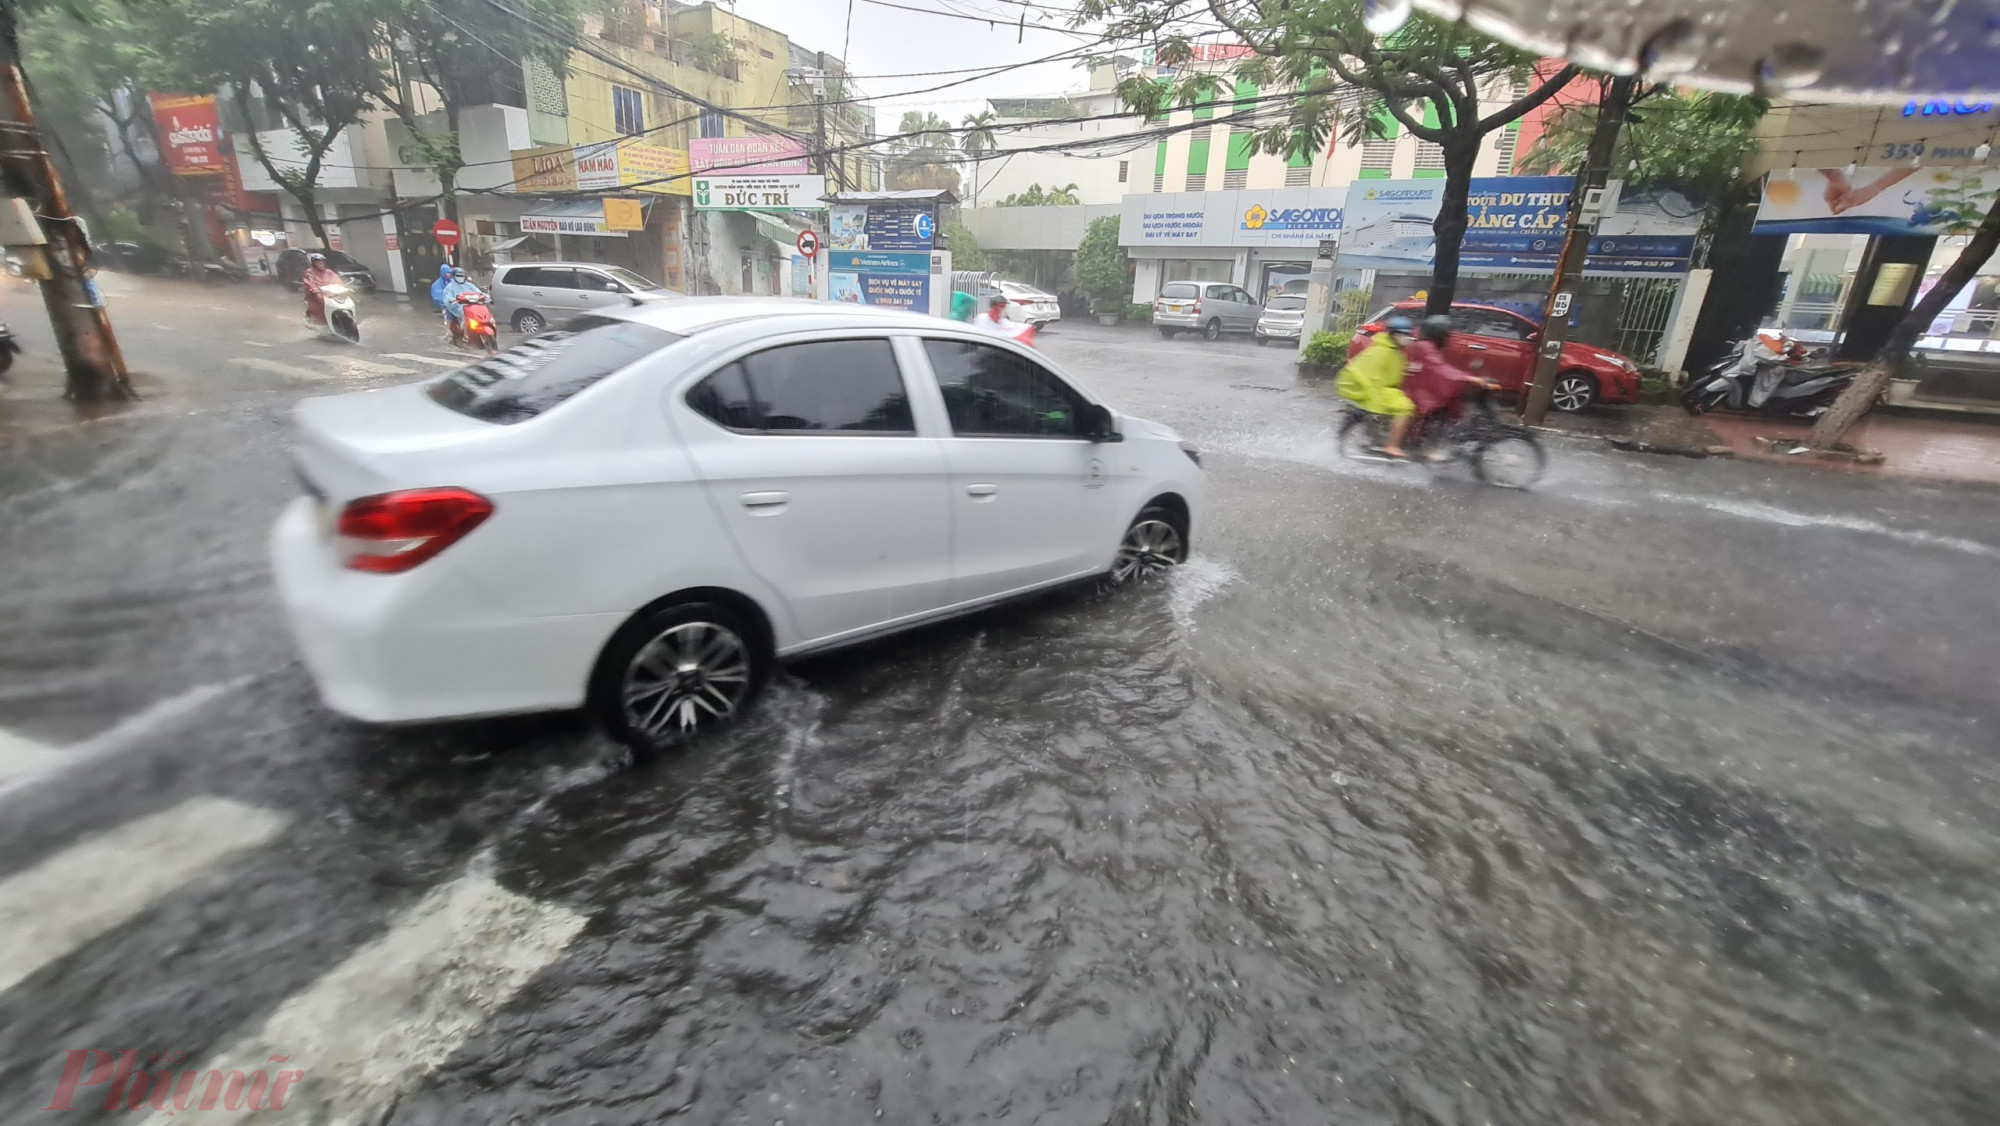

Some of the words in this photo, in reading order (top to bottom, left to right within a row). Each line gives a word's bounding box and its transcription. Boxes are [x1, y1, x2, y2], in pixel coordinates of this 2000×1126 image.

[1882, 142, 1925, 160] 359
[577, 158, 597, 173] NAM
[725, 190, 757, 206] ĐỨC
[762, 189, 789, 206] TRÍ
[1499, 193, 1526, 207] DU
[1526, 192, 1572, 207] THU
[1518, 206, 1560, 229] CẤP
[1555, 301, 1568, 309] 85
